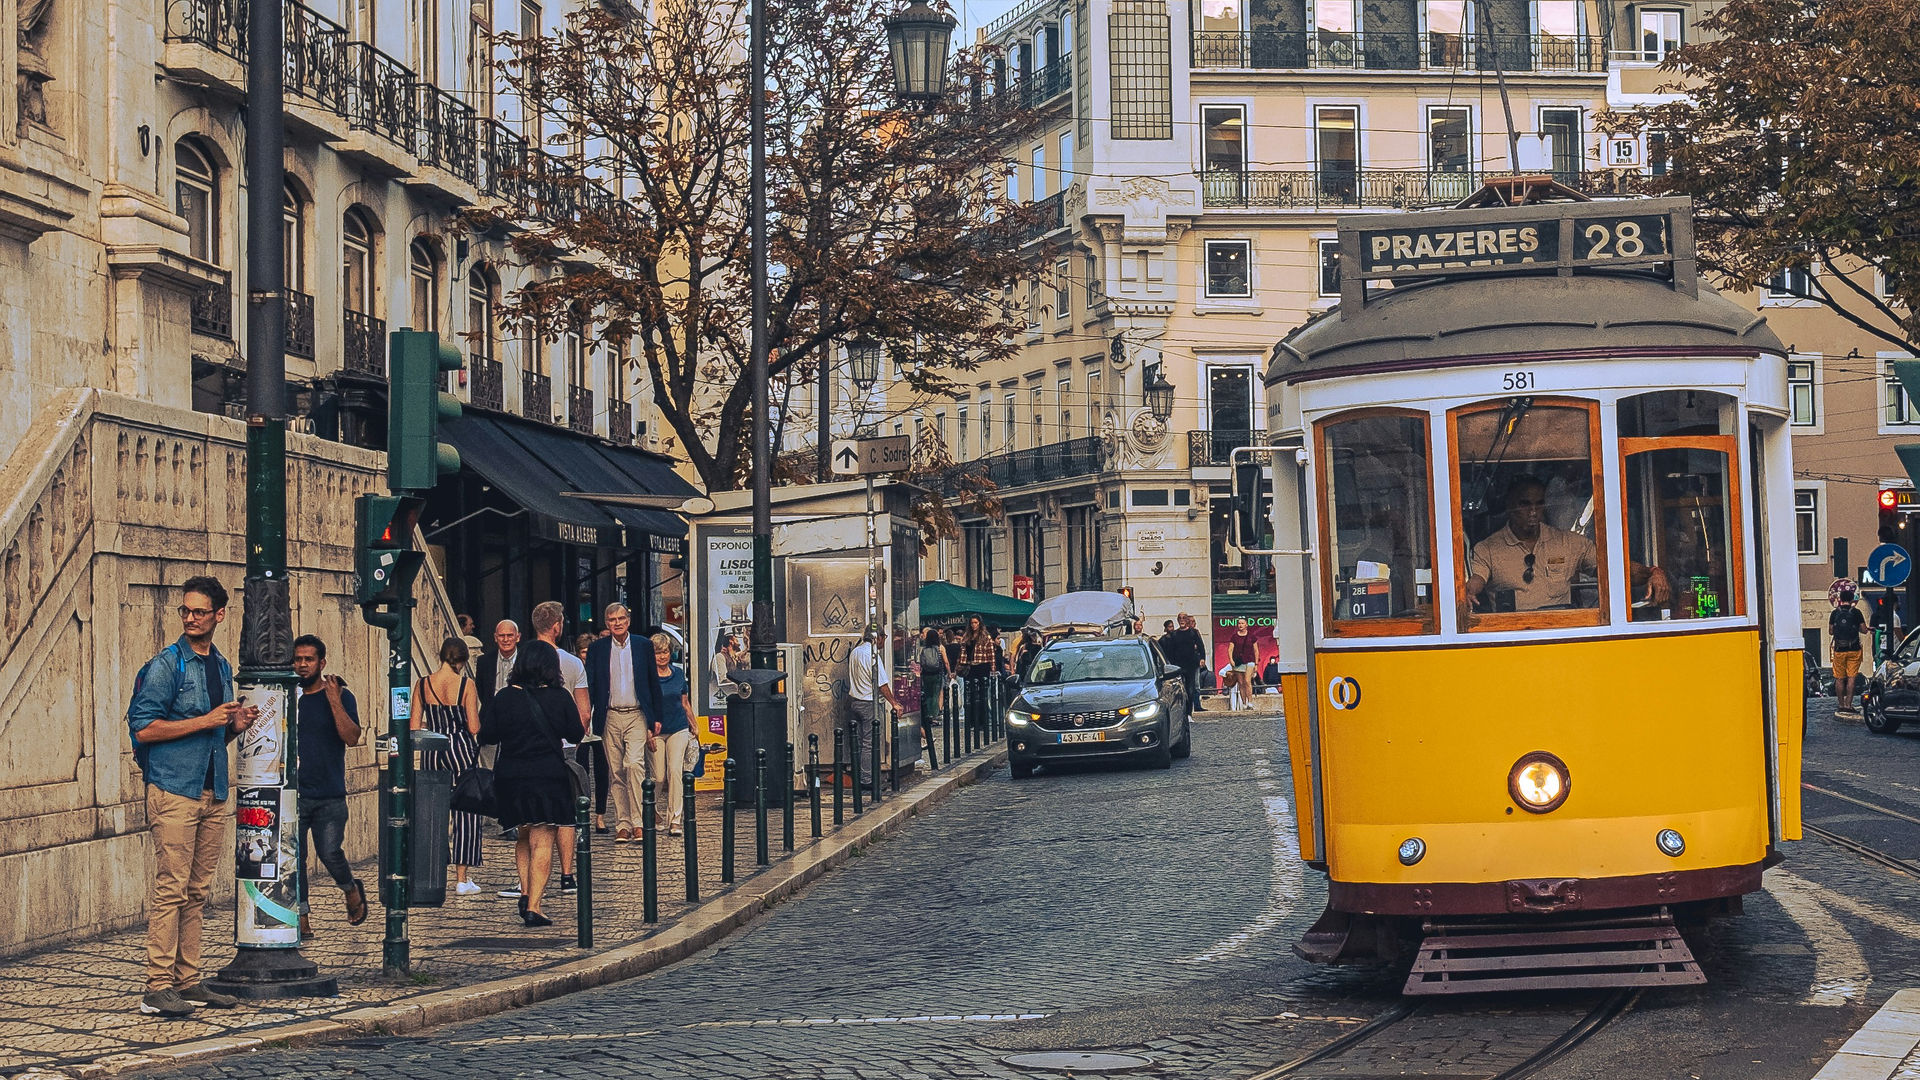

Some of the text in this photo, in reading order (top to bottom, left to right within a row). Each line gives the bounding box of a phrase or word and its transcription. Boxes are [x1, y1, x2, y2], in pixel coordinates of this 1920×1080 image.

[1614, 141, 1632, 157] 15
[1371, 221, 1644, 260] PRAZERES 28
[1503, 372, 1534, 390] 581
[870, 445, 907, 463] C. Sodré
[1352, 586, 1367, 596] 28E
[1352, 603, 1367, 616] 01
